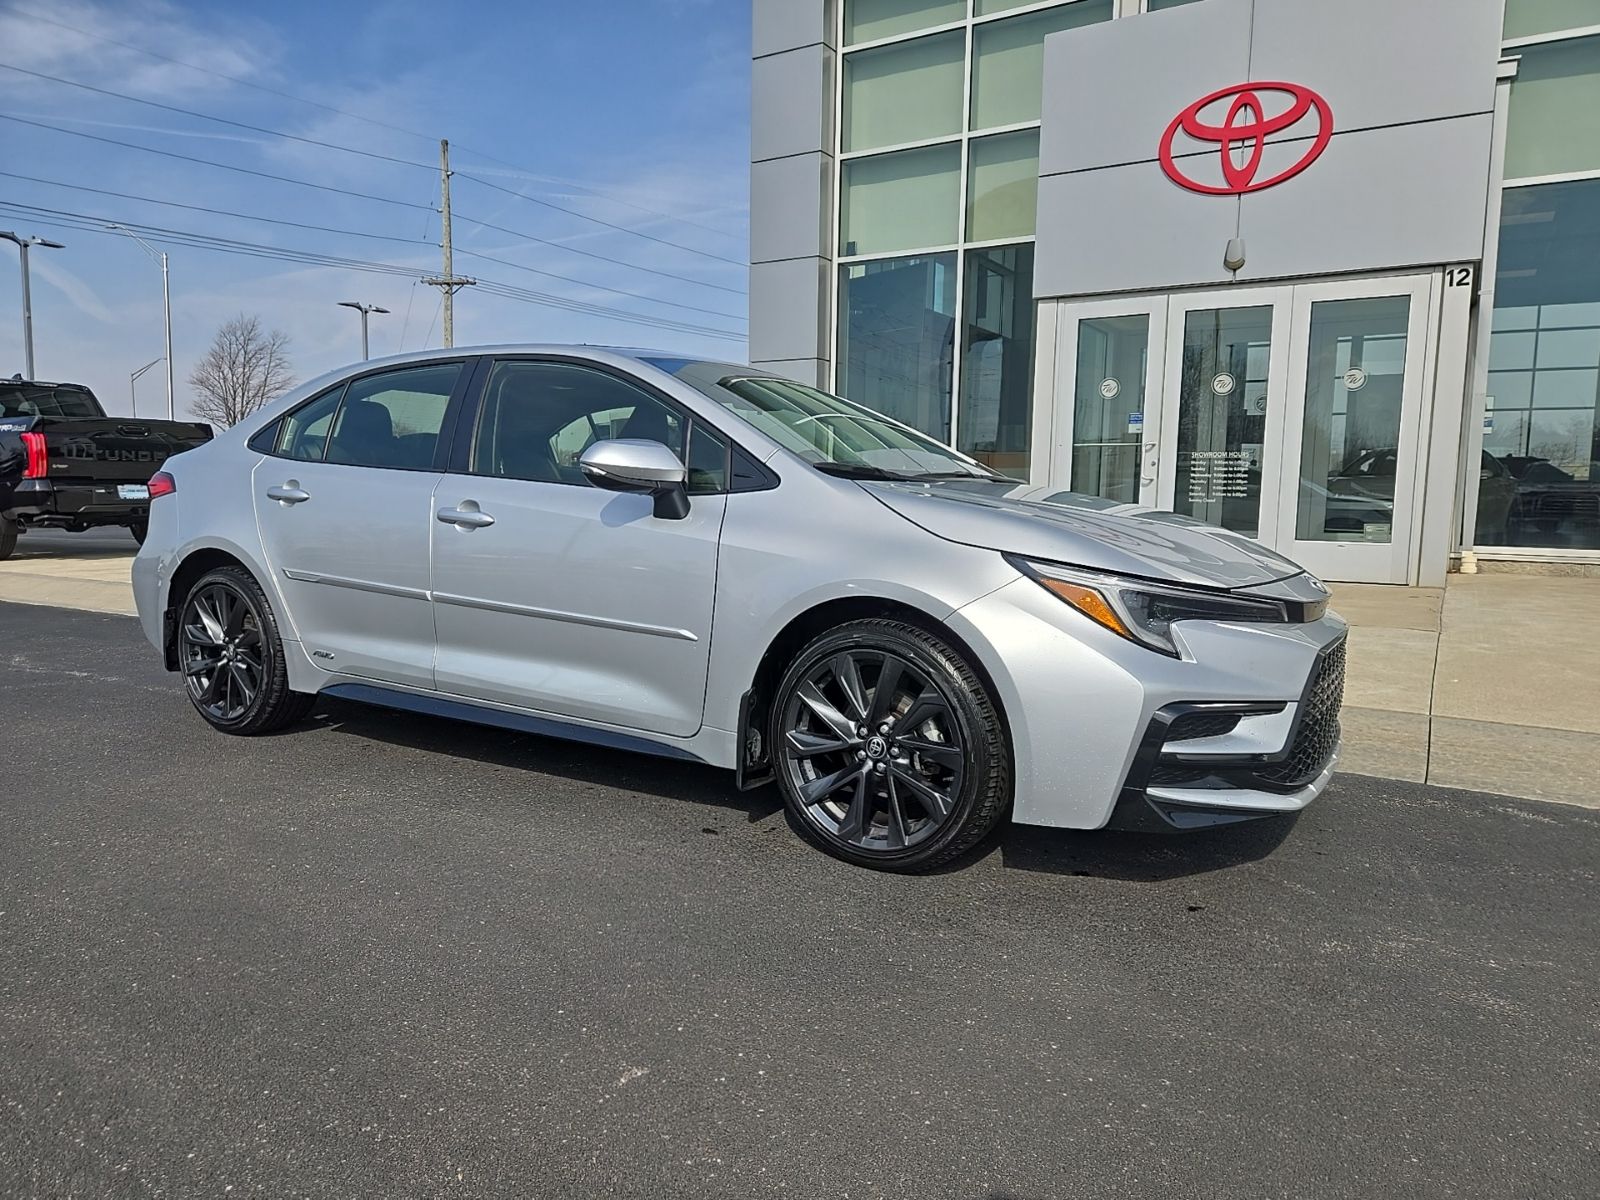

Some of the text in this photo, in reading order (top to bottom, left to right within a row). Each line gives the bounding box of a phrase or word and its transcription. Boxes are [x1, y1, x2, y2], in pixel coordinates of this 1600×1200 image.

[1446, 268, 1471, 287] 12
[1191, 451, 1228, 459] SHOWROOM
[1228, 451, 1249, 459] HOURS
